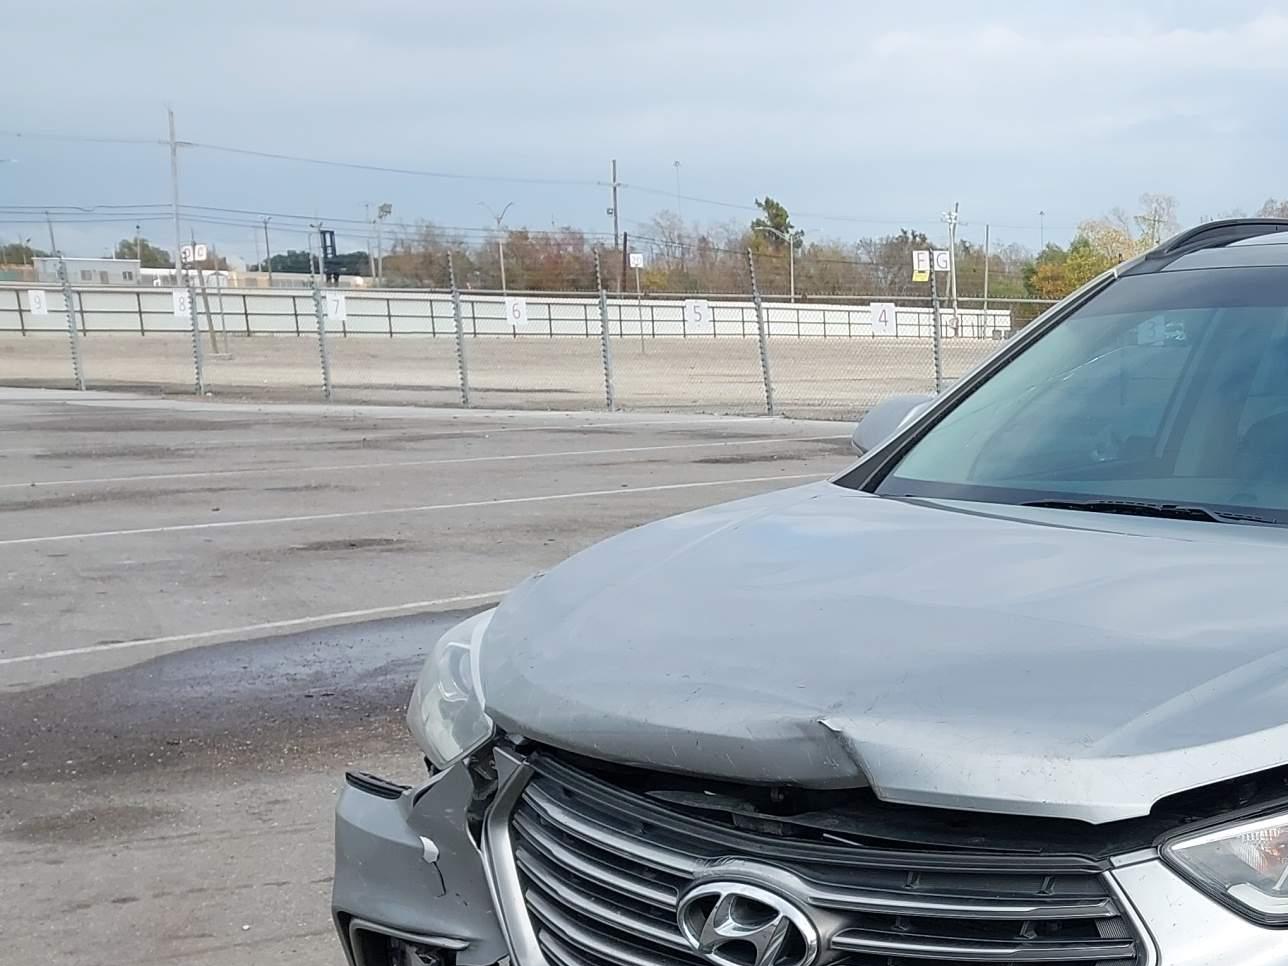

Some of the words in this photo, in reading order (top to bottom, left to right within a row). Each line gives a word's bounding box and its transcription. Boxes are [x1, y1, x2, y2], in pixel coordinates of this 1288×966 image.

[917, 252, 925, 270] F
[937, 252, 947, 269] G
[34, 295, 42, 310] 9
[179, 296, 186, 312] 8
[332, 298, 340, 314] 7
[512, 303, 521, 319] 6
[693, 305, 702, 322] 5
[878, 309, 888, 327] 4
